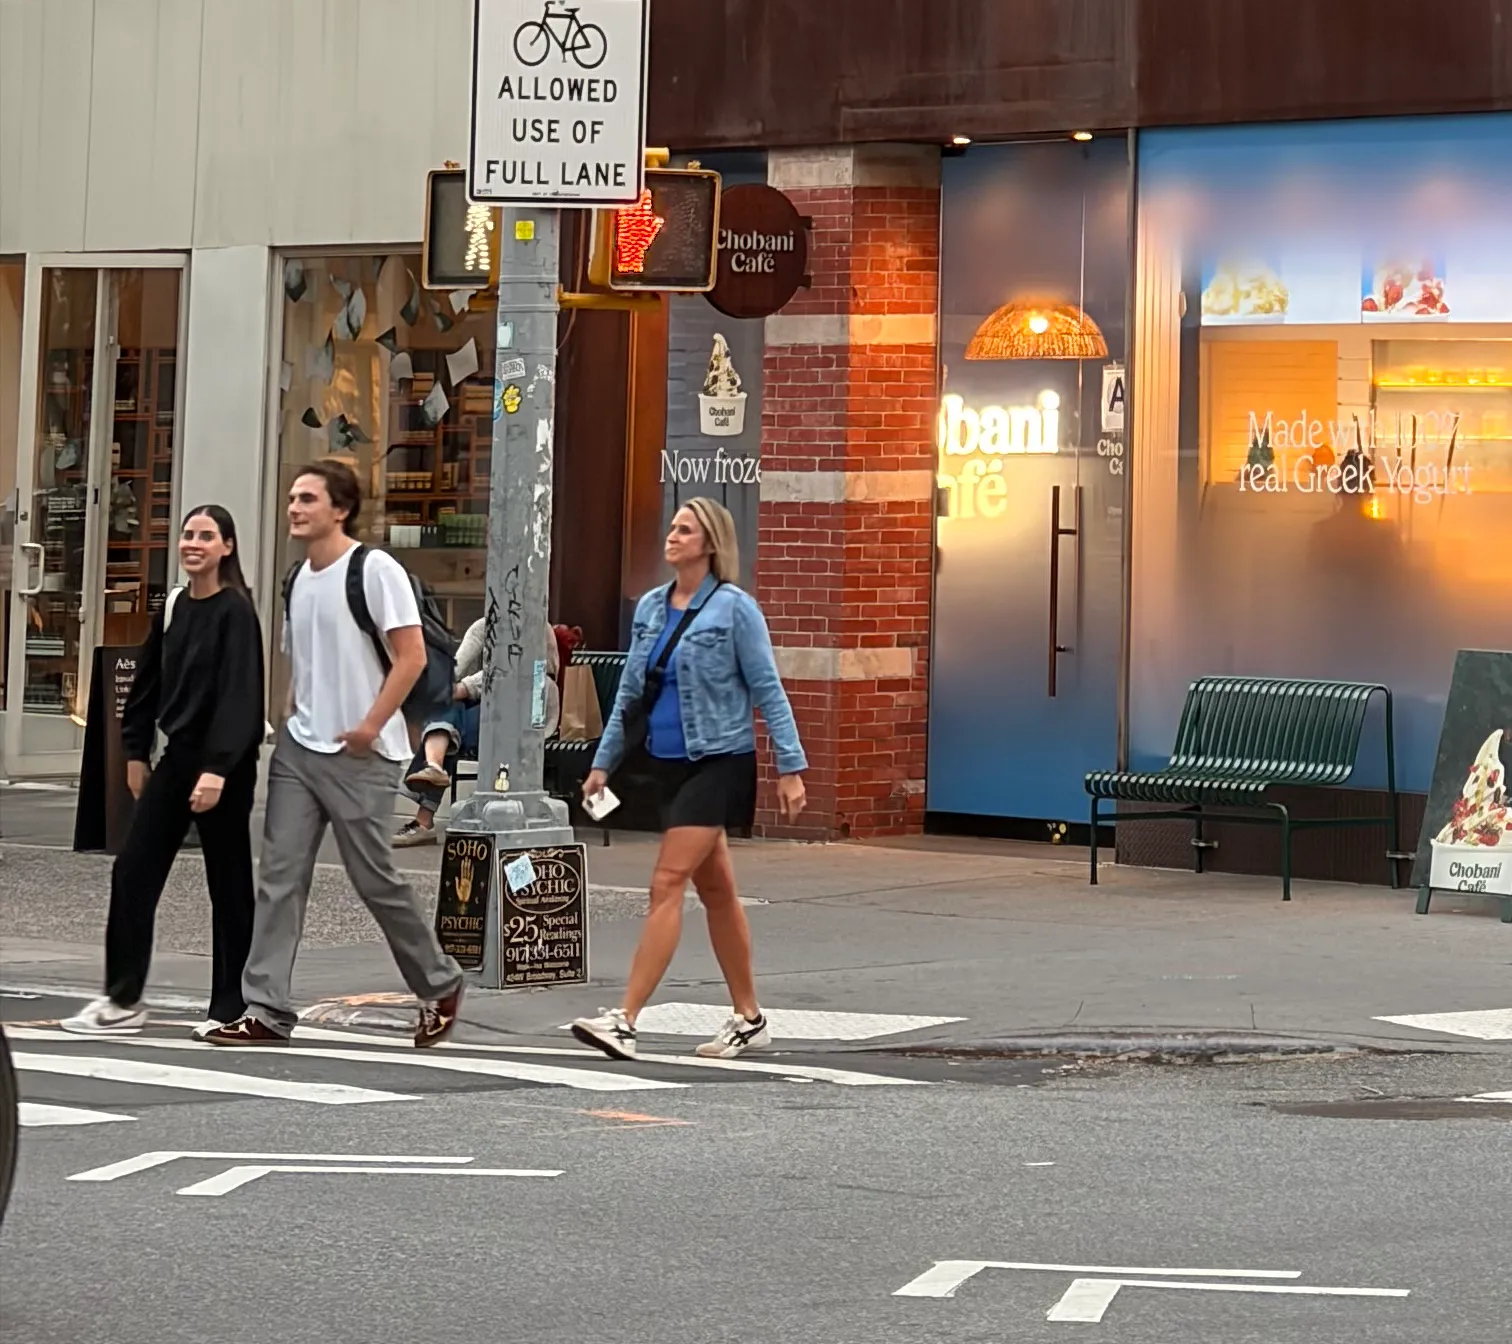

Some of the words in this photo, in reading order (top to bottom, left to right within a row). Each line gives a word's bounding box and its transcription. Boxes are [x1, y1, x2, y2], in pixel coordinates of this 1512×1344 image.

[498, 76, 617, 102] ALLOWED
[513, 118, 560, 142] USE
[572, 120, 604, 144] OF
[486, 160, 549, 184] FULL
[561, 162, 626, 186] LANE
[717, 228, 794, 251] Chobani
[731, 252, 775, 273] Café
[938, 389, 1060, 455] bani
[1248, 409, 1323, 448] Made
[660, 449, 711, 483] Now
[714, 447, 762, 484] froze
[1239, 453, 1288, 492] real
[1294, 453, 1376, 494] Greek
[1381, 455, 1473, 505] Yogurt
[447, 839, 487, 860] SOHO
[536, 864, 565, 880] OHO
[1449, 862, 1502, 879] Chobani
[513, 879, 576, 896] SYCHIC
[441, 916, 483, 930] PSYCHIC
[542, 912, 578, 929] Special
[540, 927, 582, 942] Readings
[506, 943, 580, 963] 917331-6511
